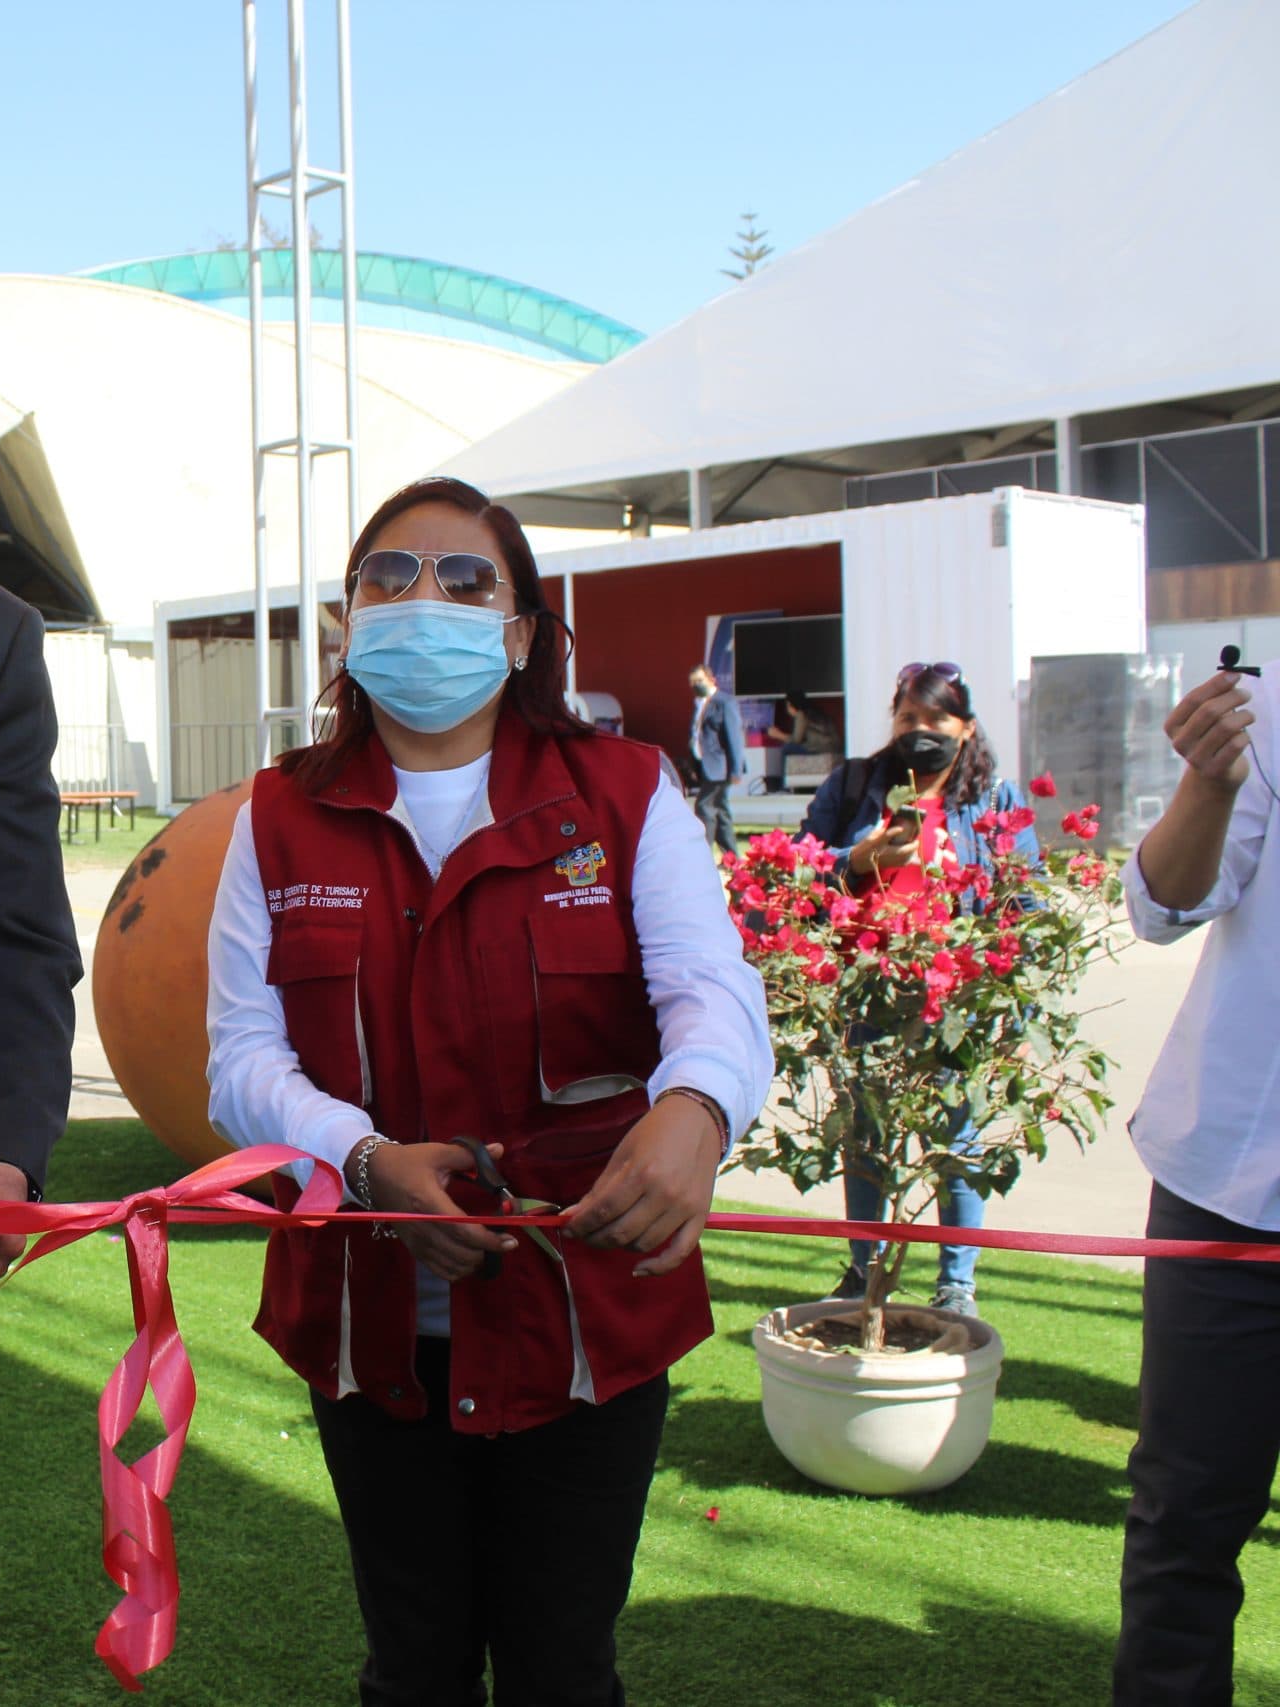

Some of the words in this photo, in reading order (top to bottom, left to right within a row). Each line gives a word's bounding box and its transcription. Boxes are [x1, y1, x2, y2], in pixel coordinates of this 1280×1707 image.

[267, 889, 281, 900] SUB
[284, 884, 309, 898] GERENTE
[311, 884, 322, 894] DE
[325, 886, 360, 896] TURISMO
[363, 887, 369, 897] Y
[309, 896, 362, 909] EXTERIORES
[559, 899, 569, 909] DE
[574, 895, 610, 906] AREQUIPA
